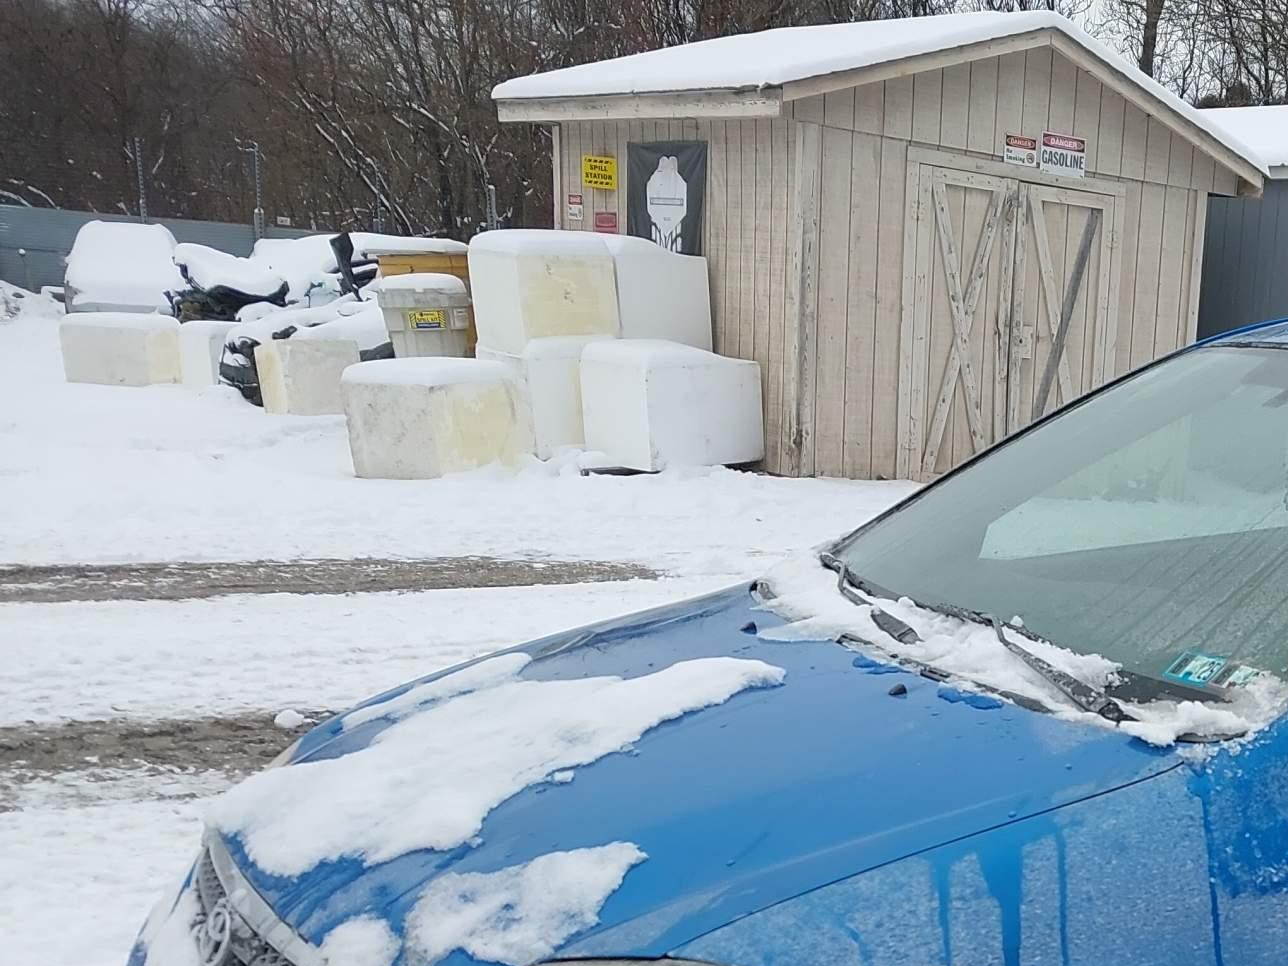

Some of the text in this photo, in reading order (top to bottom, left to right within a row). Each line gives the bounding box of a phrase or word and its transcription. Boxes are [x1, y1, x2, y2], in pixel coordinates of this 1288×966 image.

[1010, 138, 1032, 147] DANGER
[1050, 137, 1078, 148] DANGER
[1041, 149, 1084, 170] GASOLINE
[589, 164, 608, 172] SPILL
[585, 172, 612, 181] STATION
